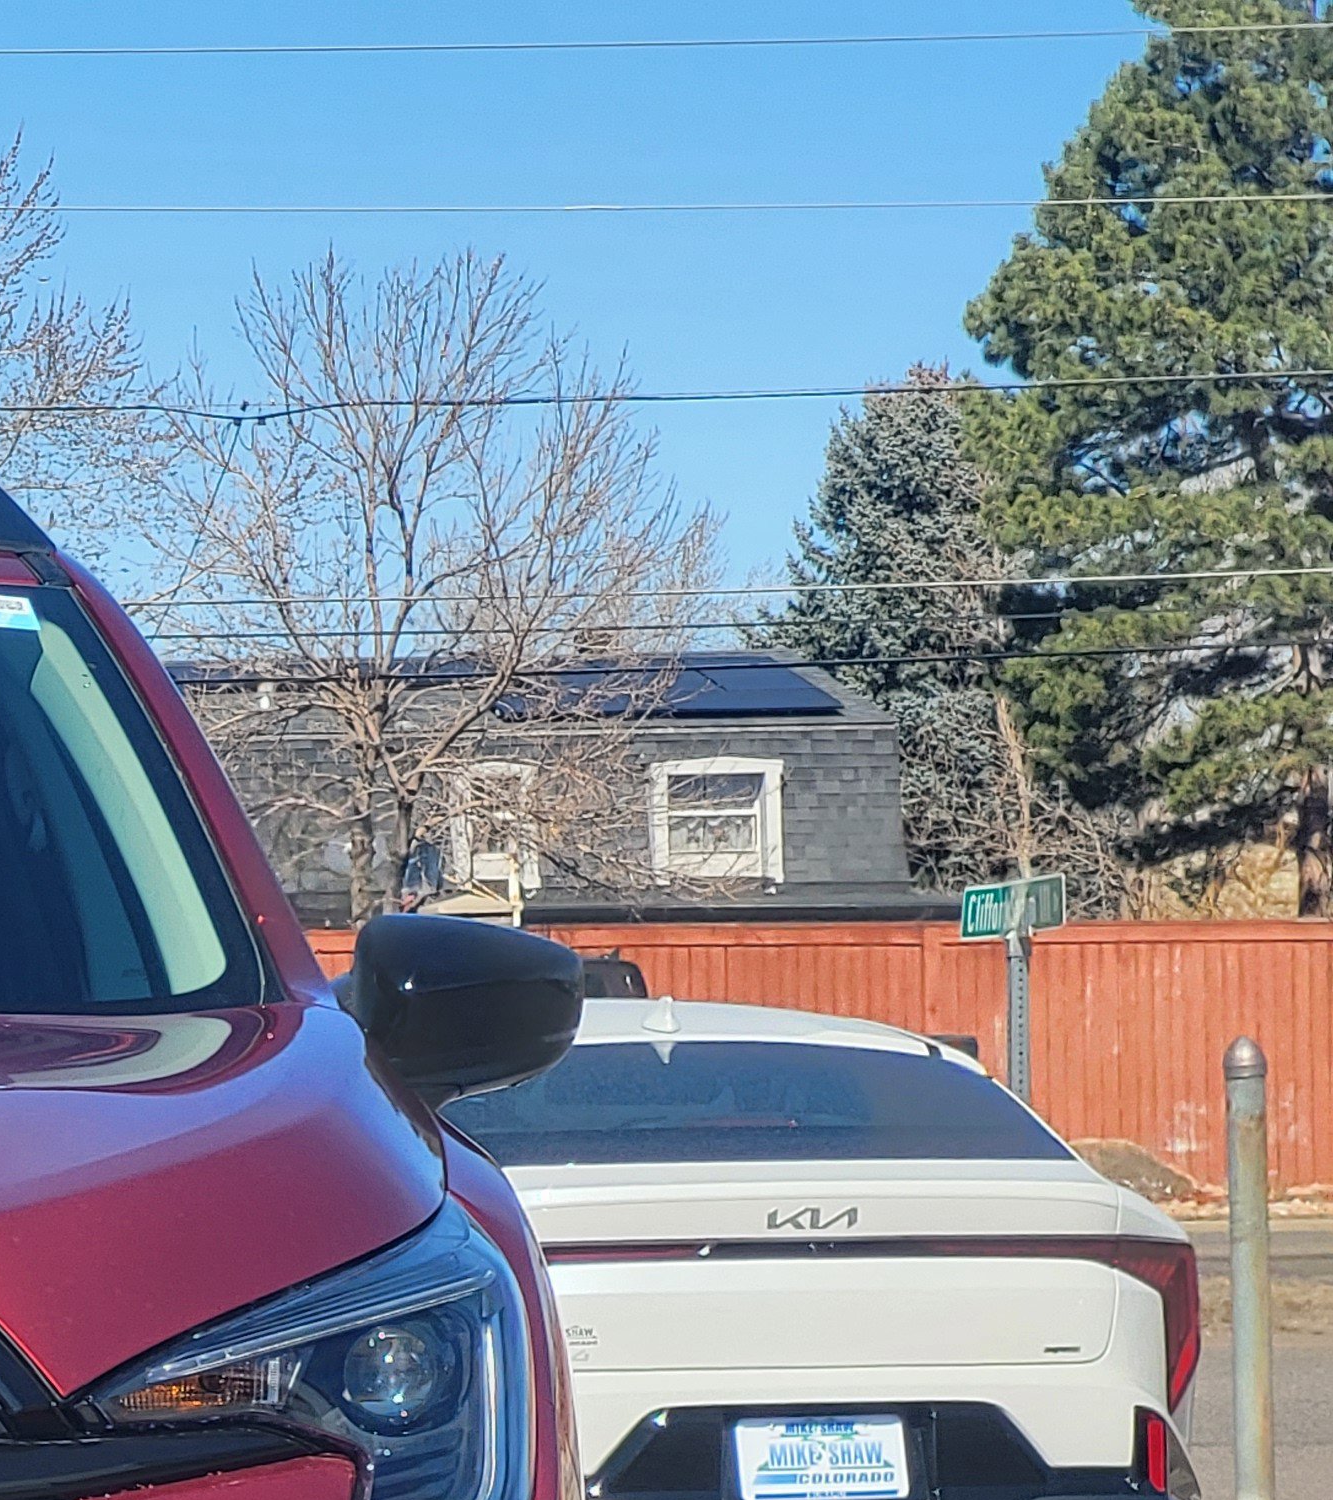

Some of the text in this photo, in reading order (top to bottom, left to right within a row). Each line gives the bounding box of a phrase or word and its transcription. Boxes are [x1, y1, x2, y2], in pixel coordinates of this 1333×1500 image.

[767, 1207, 858, 1230] KIA
[769, 1441, 882, 1467] MIKE SHAW
[798, 1471, 895, 1485] COLORADO
